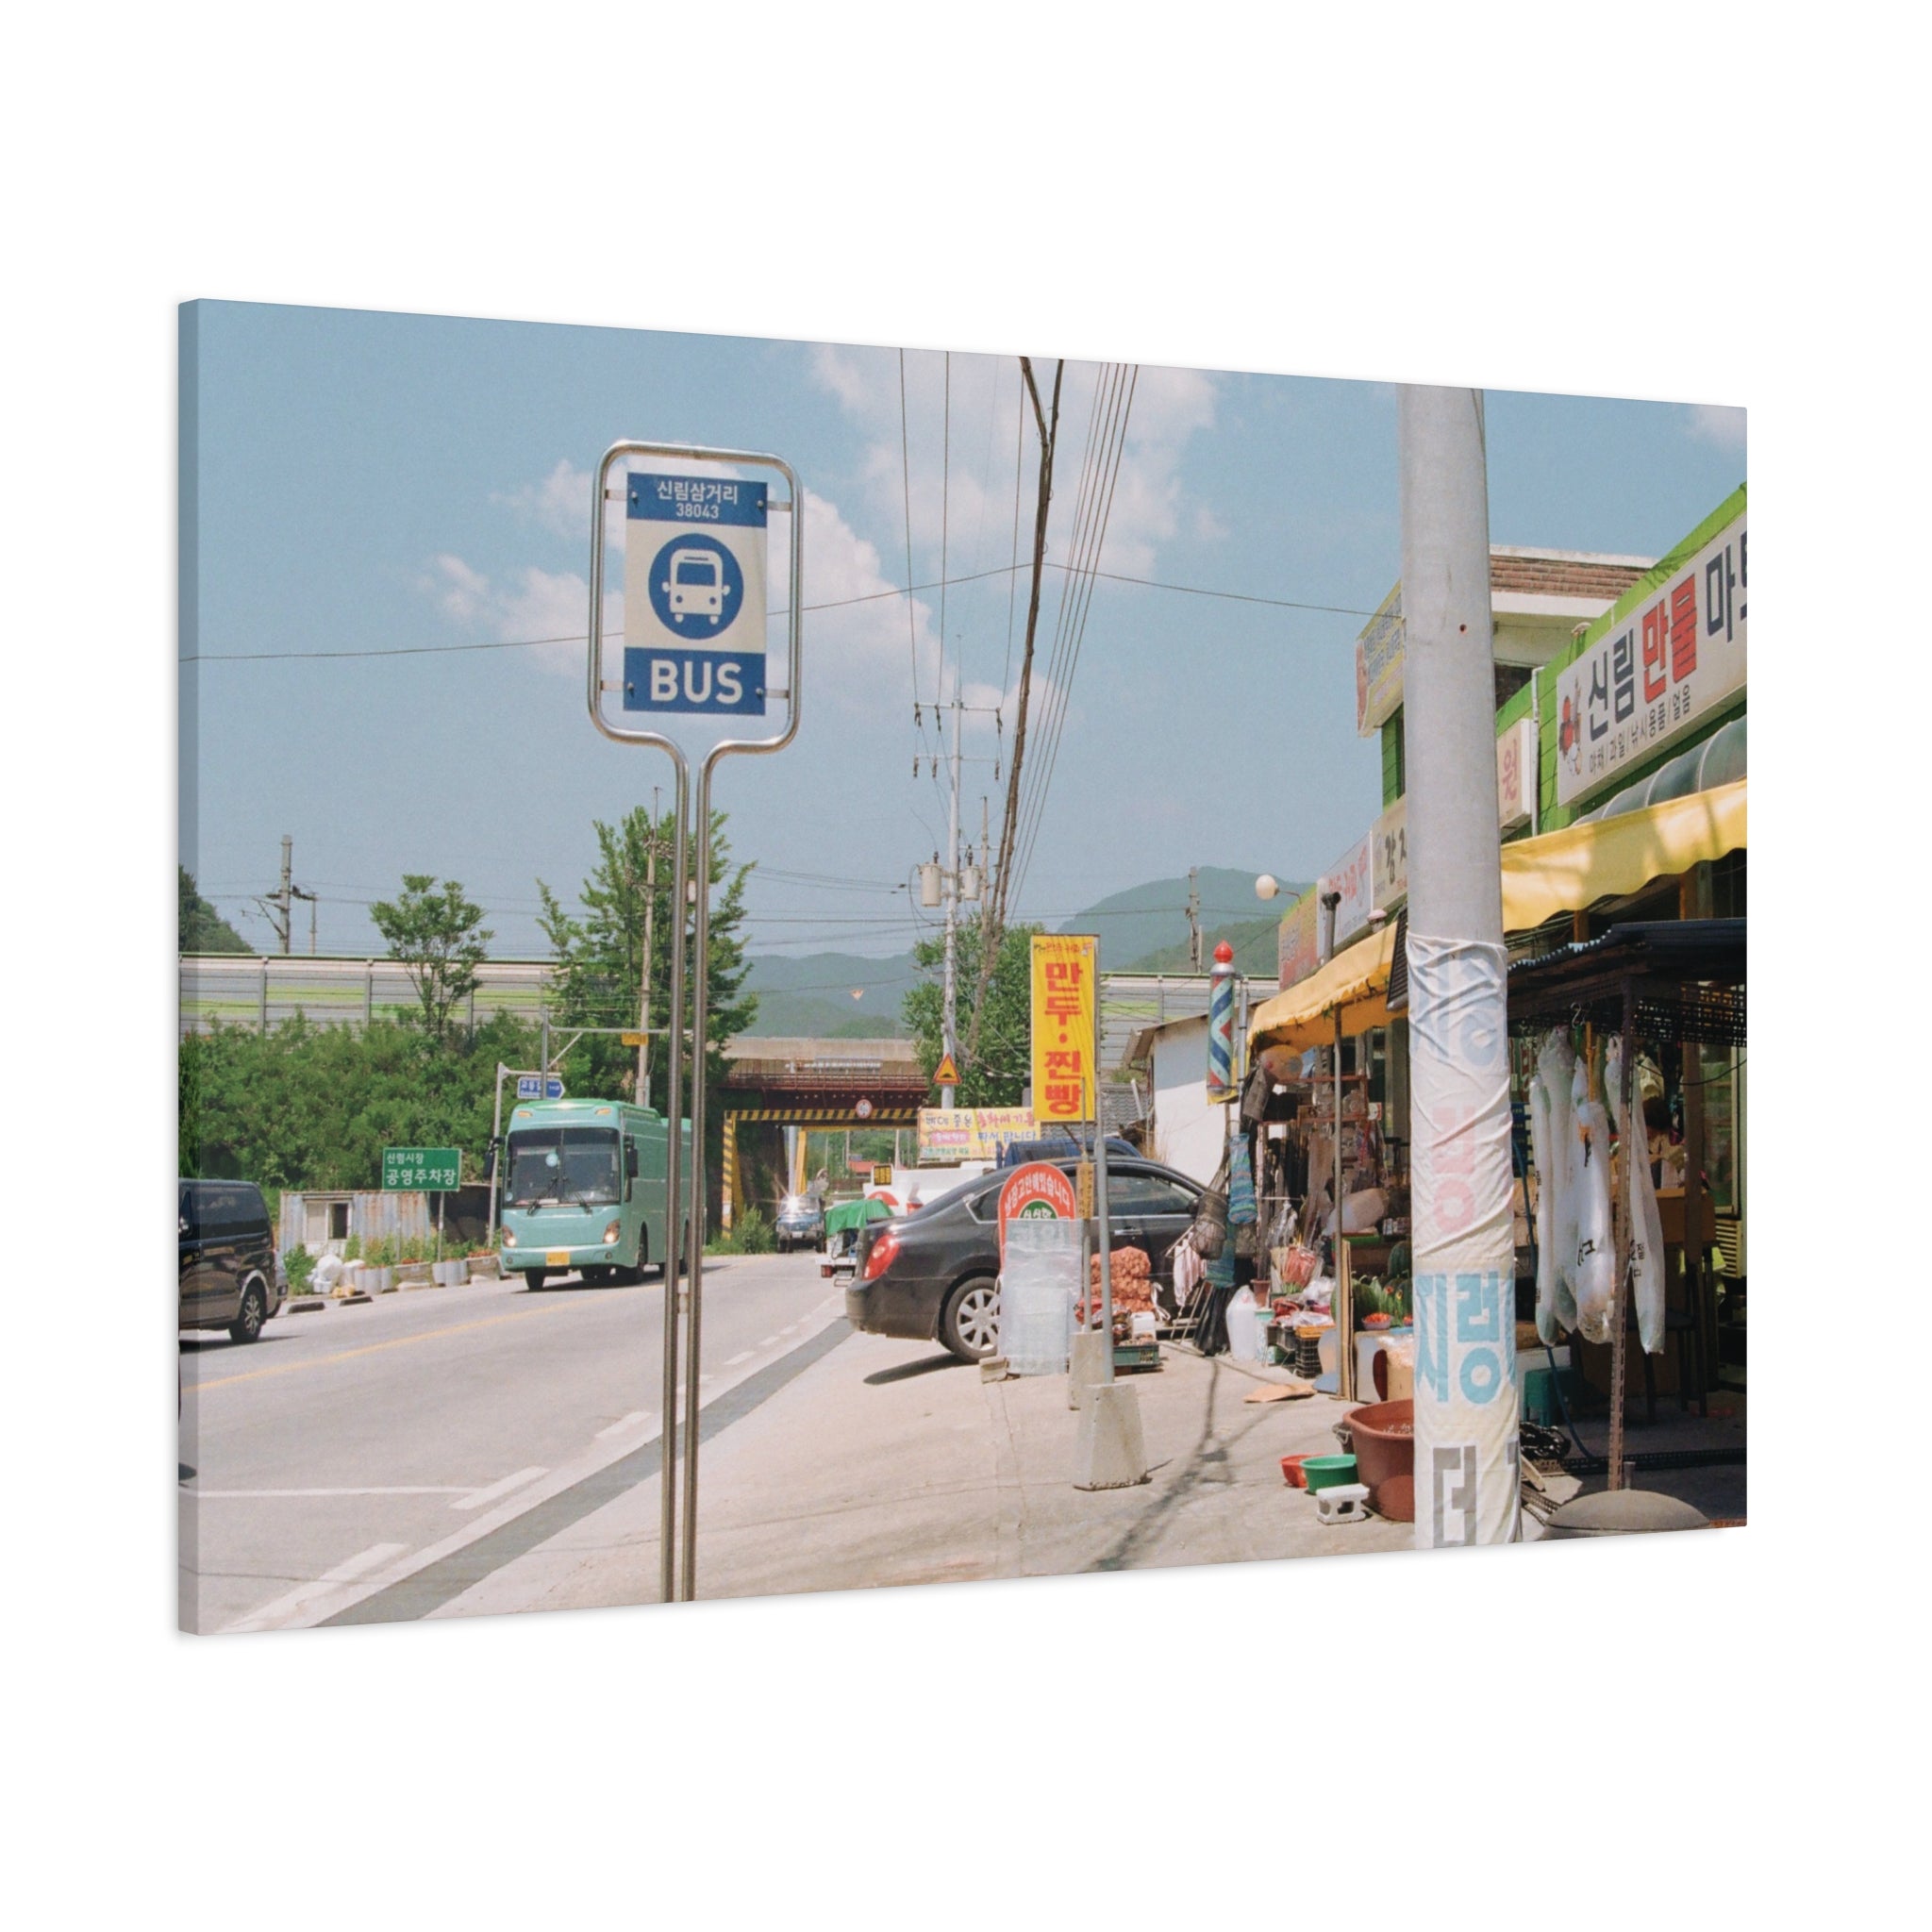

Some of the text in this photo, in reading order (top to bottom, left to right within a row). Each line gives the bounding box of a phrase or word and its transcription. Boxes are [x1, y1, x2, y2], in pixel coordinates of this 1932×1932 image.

[658, 480, 738, 505] 신림삼거리
[675, 503, 720, 519] 38043
[1641, 573, 1697, 704] 만물
[1706, 529, 1747, 643] 마
[650, 658, 743, 705] BUS
[386, 1152, 425, 1165] 신림시장
[385, 1168, 457, 1186] 공영주차장
